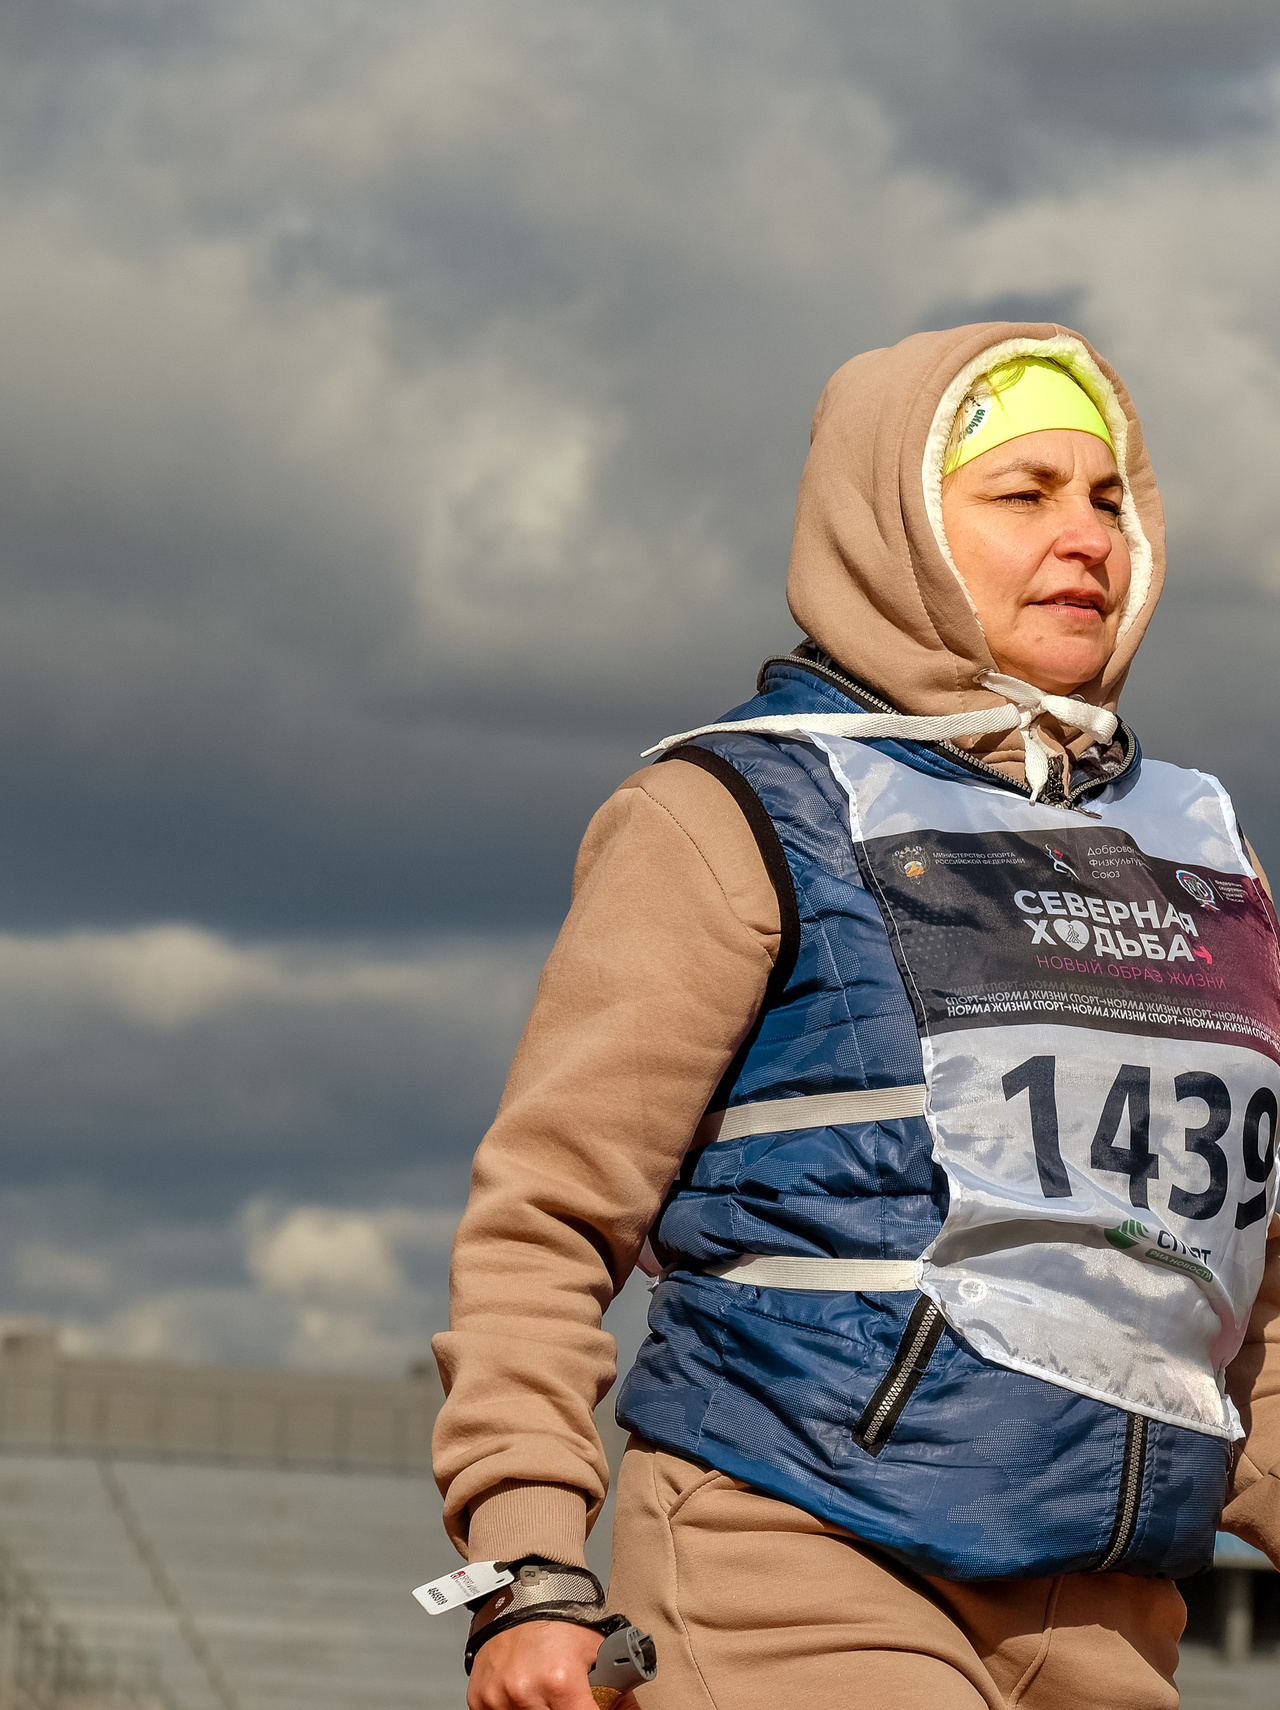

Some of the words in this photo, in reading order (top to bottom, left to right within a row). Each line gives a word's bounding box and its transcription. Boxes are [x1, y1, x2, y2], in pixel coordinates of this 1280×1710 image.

[1091, 870, 1120, 879] Союз
[1014, 889, 1199, 937] СЕВЕРНАЯ
[1036, 955, 1103, 975] НОВЫЙ
[1107, 964, 1163, 983] ОБРАЗ
[1167, 971, 1227, 990] ЖИЗНИ
[945, 995, 979, 1006] СПОРТ
[987, 990, 1029, 1003] НОРМА
[1029, 990, 1068, 1002] ЖИЗНИ
[1069, 993, 1099, 1006] СПОРТ
[1106, 998, 1144, 1012] НОРМА
[1144, 1002, 1182, 1016] ЖИЗНИ
[1182, 1007, 1212, 1019] СПОРТ
[1217, 1011, 1250, 1026] НОРМА
[947, 1003, 991, 1017] НОРМА
[991, 1001, 1032, 1013] ЖИЗНИ
[1033, 1000, 1065, 1012] СПОРТ
[1071, 1003, 1110, 1018] НОРМА
[1109, 1008, 1147, 1022] ЖИЗНИ
[1148, 1012, 1178, 1026] СПОРТ
[1185, 1017, 1221, 1031] НОРМА
[1221, 1021, 1253, 1036] ЖИЗНИ
[1001, 1055, 1278, 1230] 1439
[1150, 1250, 1169, 1261] РИА
[1169, 1259, 1213, 1281] НОВОСТИ
